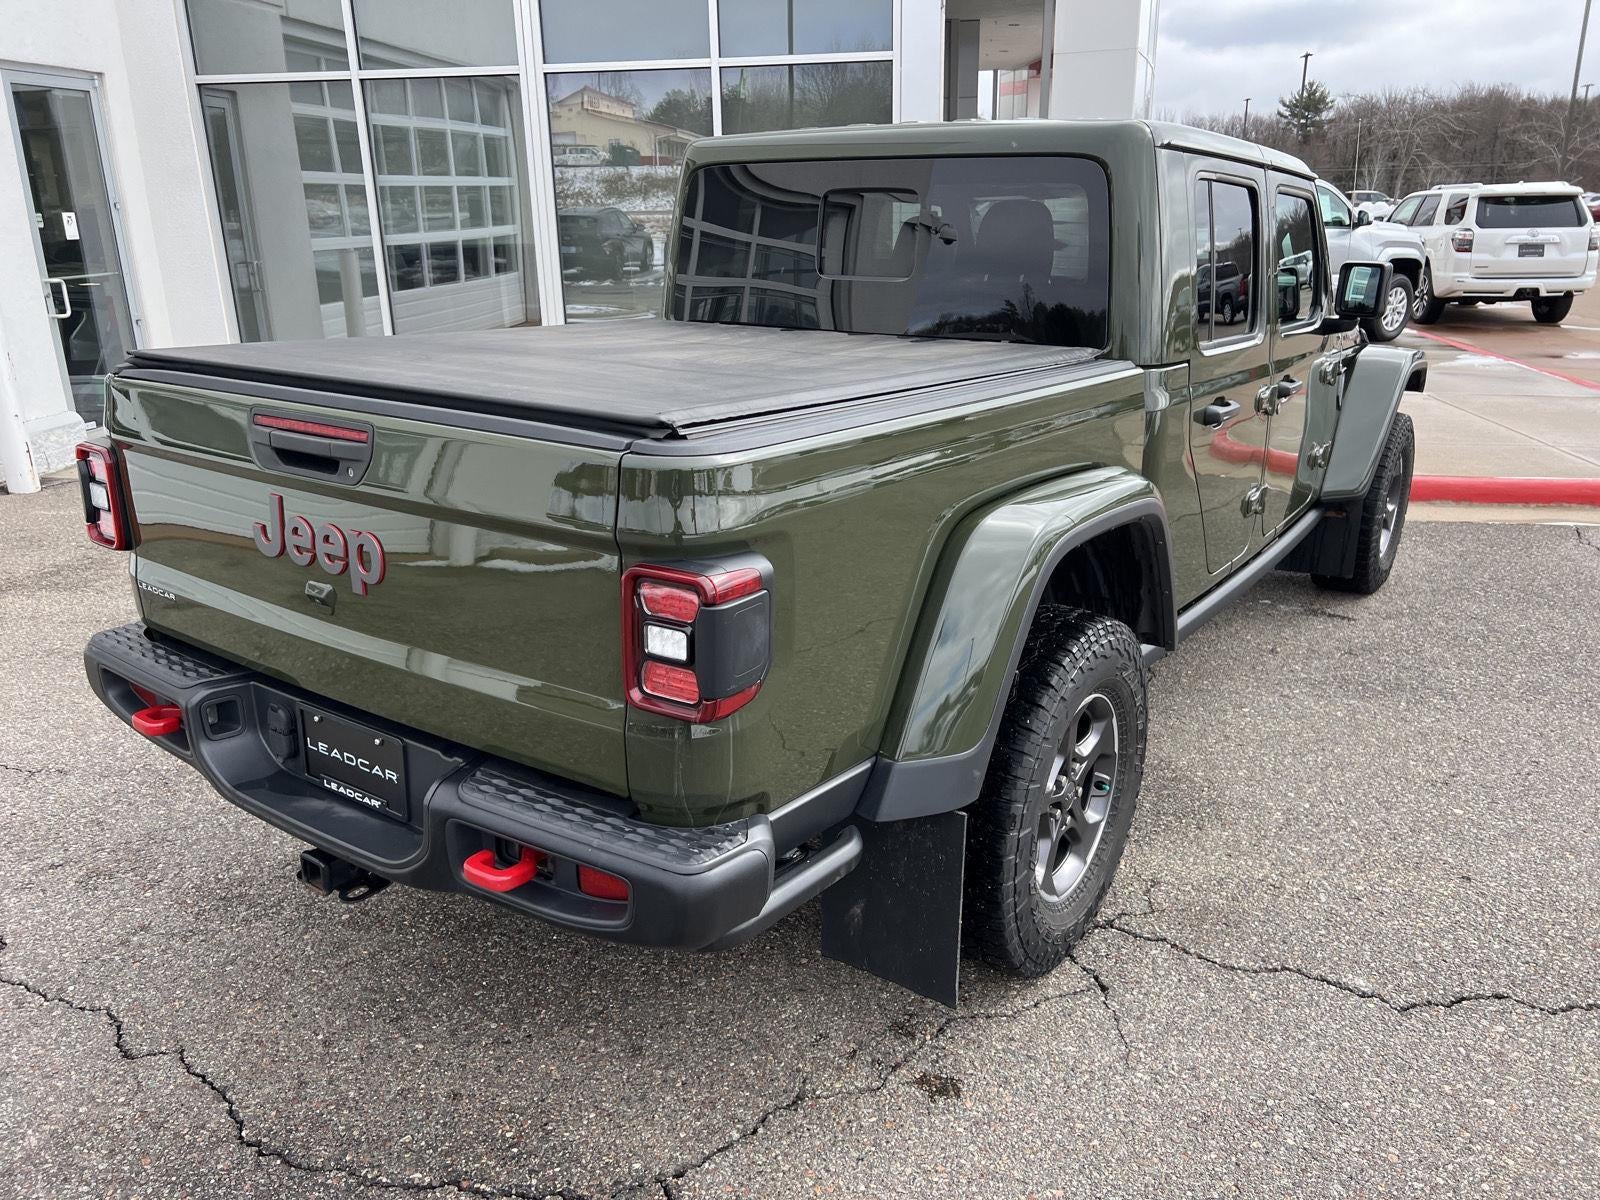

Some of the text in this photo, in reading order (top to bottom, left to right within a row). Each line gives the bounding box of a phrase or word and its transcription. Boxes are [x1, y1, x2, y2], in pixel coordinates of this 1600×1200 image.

[253, 493, 385, 597] Jeep
[138, 580, 176, 601] LEADCAR
[307, 737, 398, 784] LEADCAR
[323, 779, 381, 809] LEADCAR
